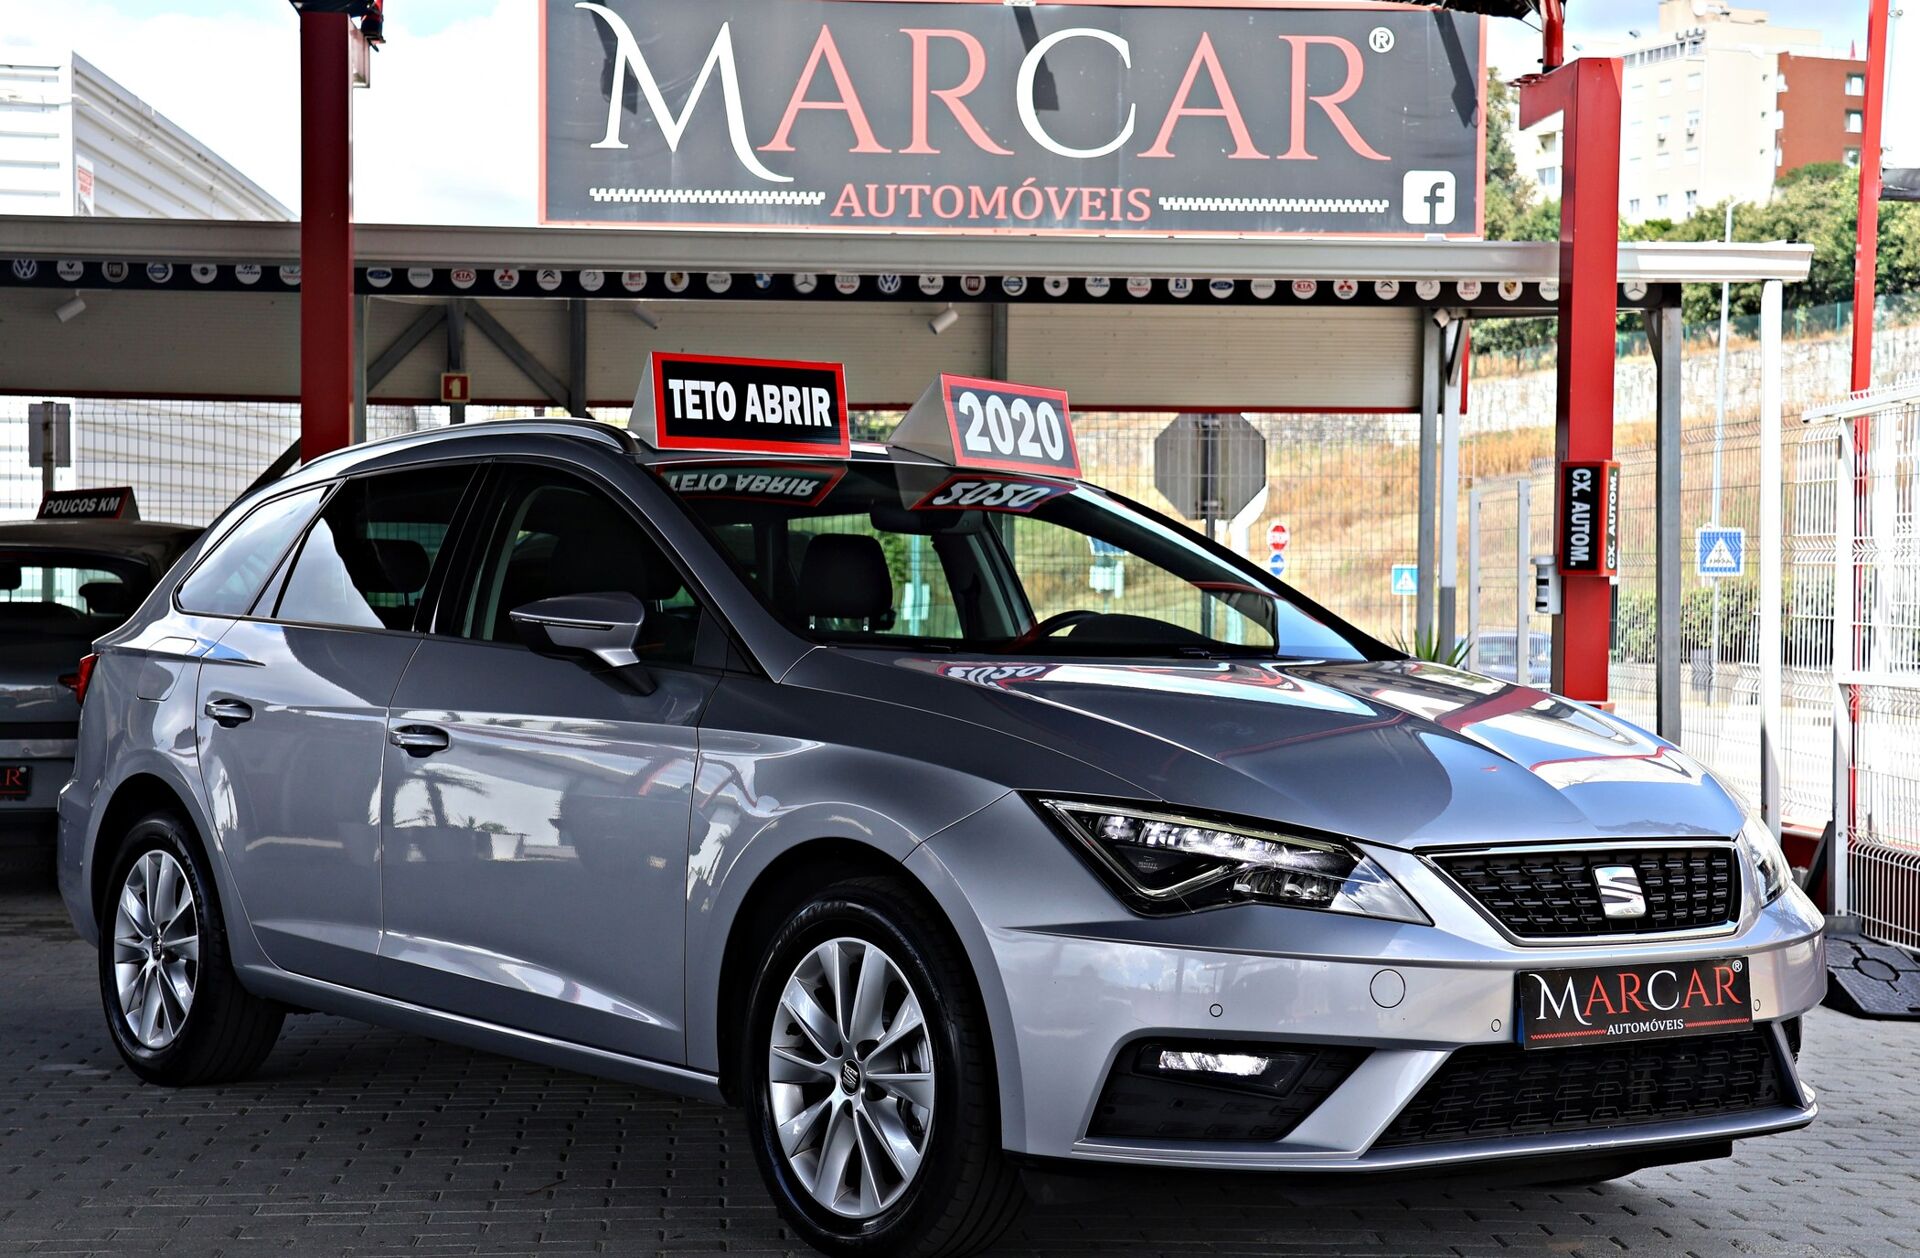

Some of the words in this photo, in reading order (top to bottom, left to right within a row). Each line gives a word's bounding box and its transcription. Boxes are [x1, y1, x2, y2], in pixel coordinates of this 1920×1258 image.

[831, 177, 1151, 222] AUTOMÓVEIS
[668, 378, 736, 422] TETO
[745, 383, 832, 428] ABRIR
[958, 391, 1065, 461] 2020
[44, 498, 97, 514] POUCOS
[98, 497, 120, 512] KM
[1572, 468, 1592, 497] CX.
[1608, 471, 1618, 536] AUTOM.
[1570, 501, 1591, 566] AUTOM.
[1528, 966, 1743, 1026] MARCAR
[1606, 1018, 1684, 1036] AUTOMÓVEIS
